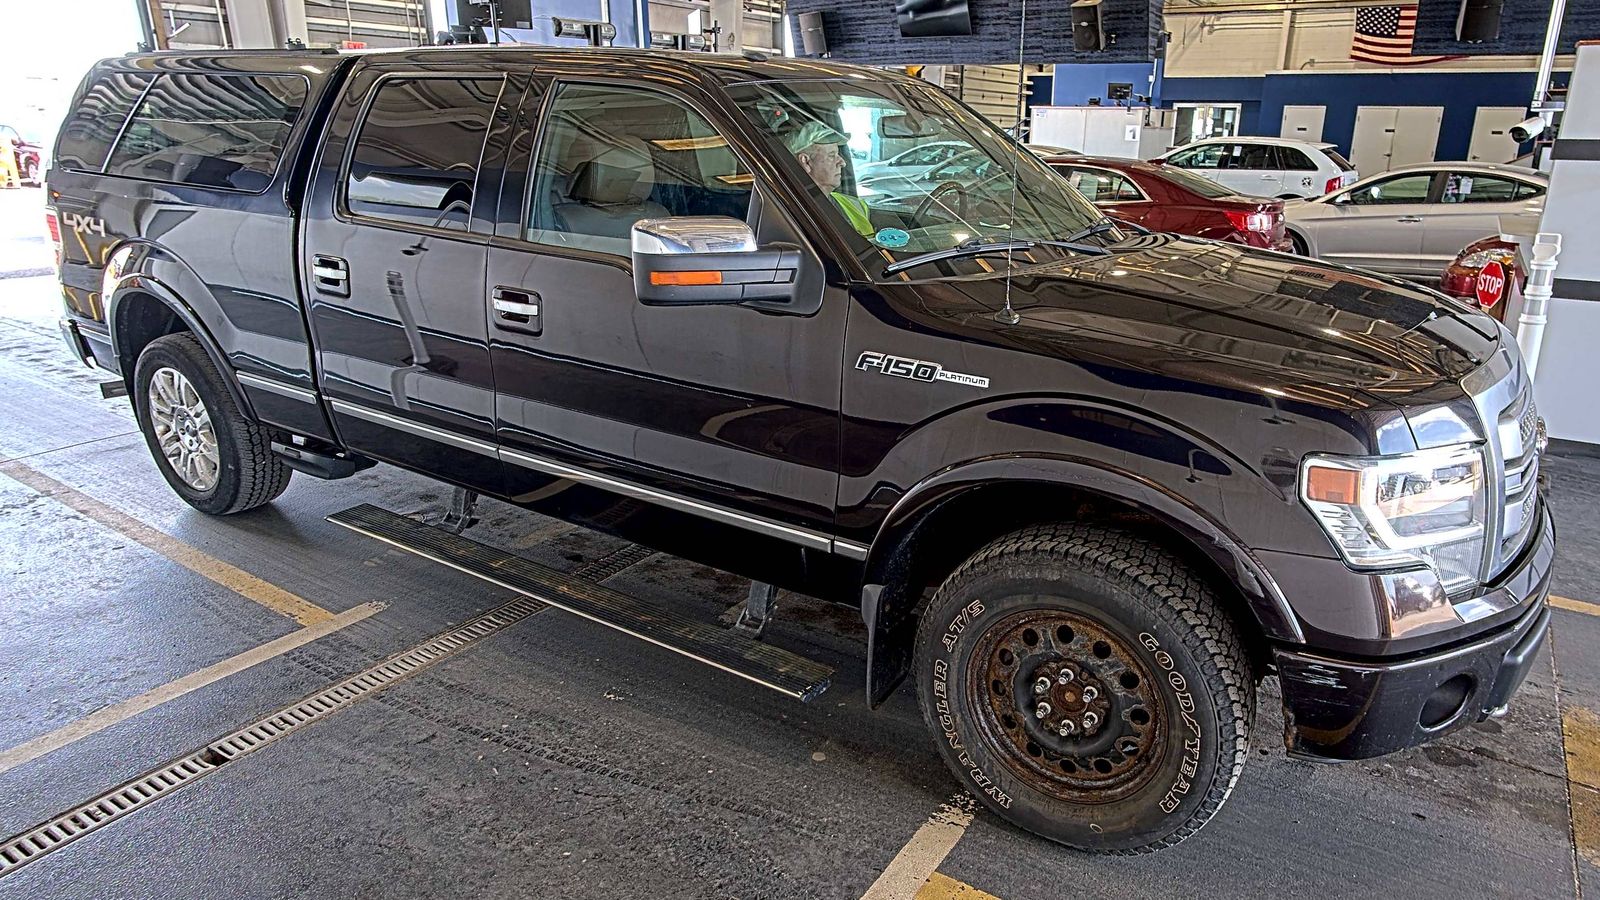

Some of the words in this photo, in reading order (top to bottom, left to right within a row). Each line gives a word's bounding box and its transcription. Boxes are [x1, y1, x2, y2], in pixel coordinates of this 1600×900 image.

[1129, 127, 1137, 140] 1
[1478, 274, 1503, 295] STOP
[855, 350, 943, 383] F-150
[938, 371, 988, 387] PLATINUM
[943, 599, 985, 652] AT/S
[933, 659, 1013, 810] WRANGLER
[1138, 631, 1202, 814] GOODYEAR
